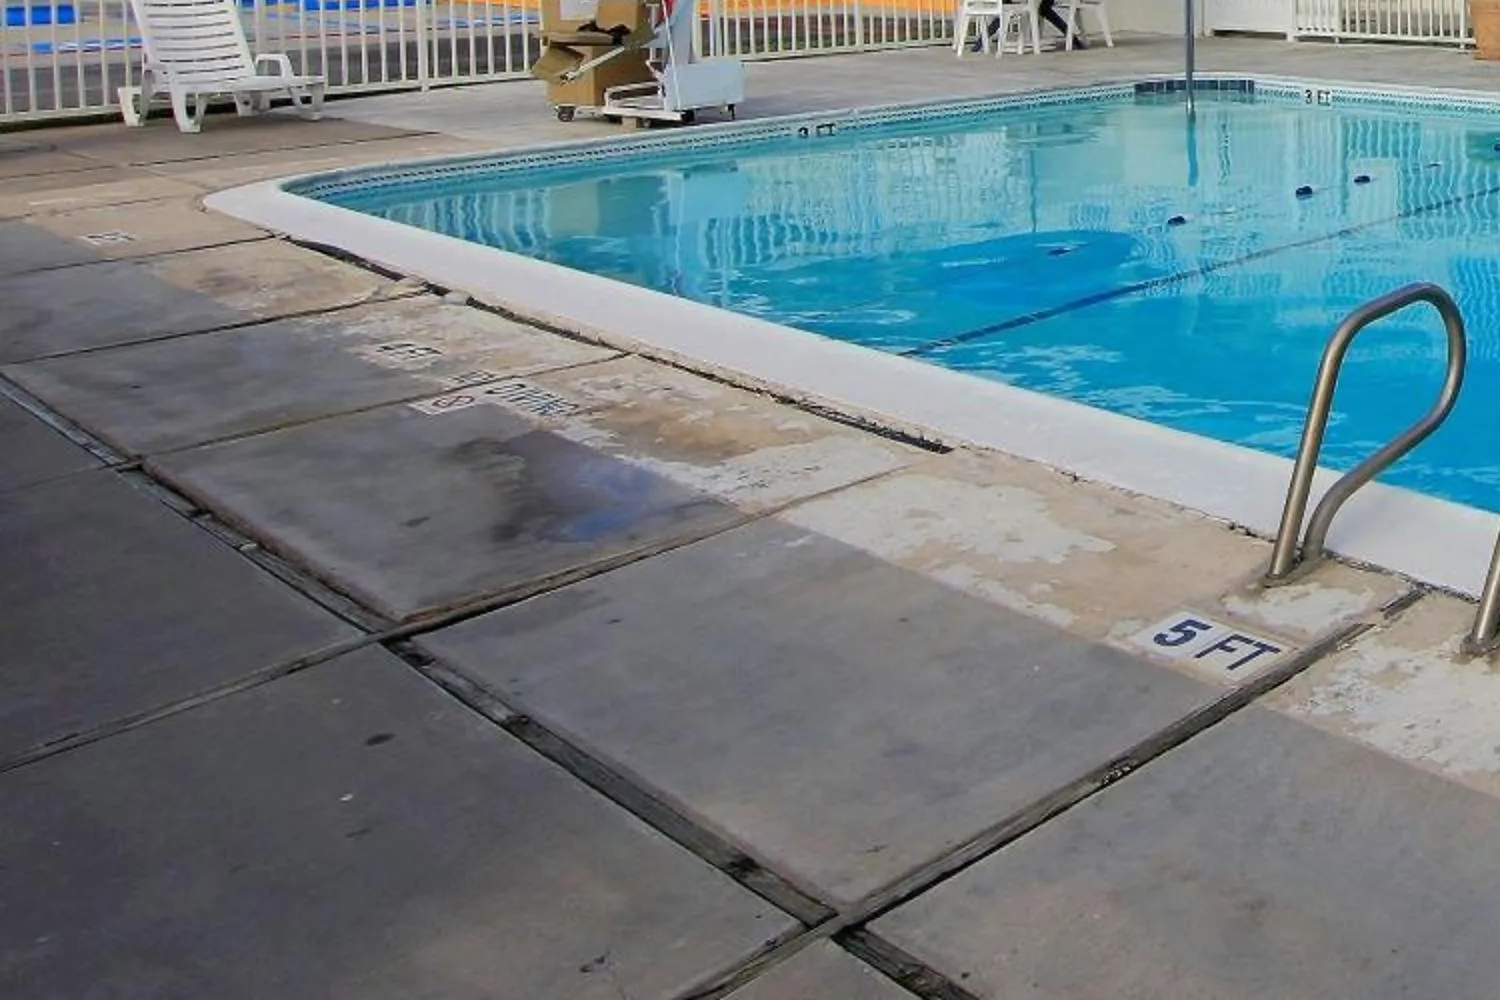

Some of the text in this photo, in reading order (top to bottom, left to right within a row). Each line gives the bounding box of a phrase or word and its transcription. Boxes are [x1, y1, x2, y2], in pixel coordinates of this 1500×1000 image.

[1305, 89, 1313, 104] 3
[1153, 618, 1281, 671] 5 FT
